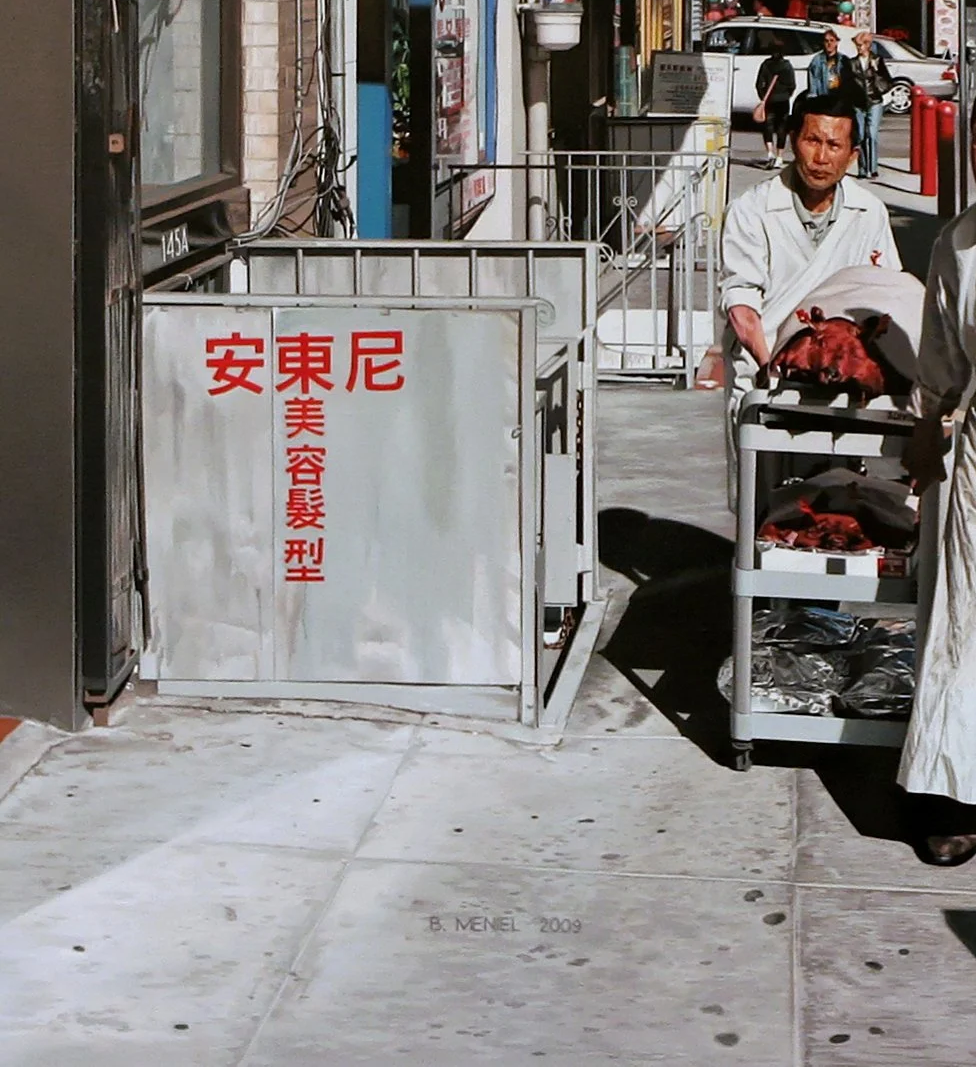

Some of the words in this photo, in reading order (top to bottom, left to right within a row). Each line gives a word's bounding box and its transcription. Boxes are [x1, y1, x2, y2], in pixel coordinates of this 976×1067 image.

[161, 229, 190, 263] 145A
[205, 330, 405, 396] 安東尼
[284, 397, 327, 583] 美容髮型
[539, 918, 582, 933] 2009
